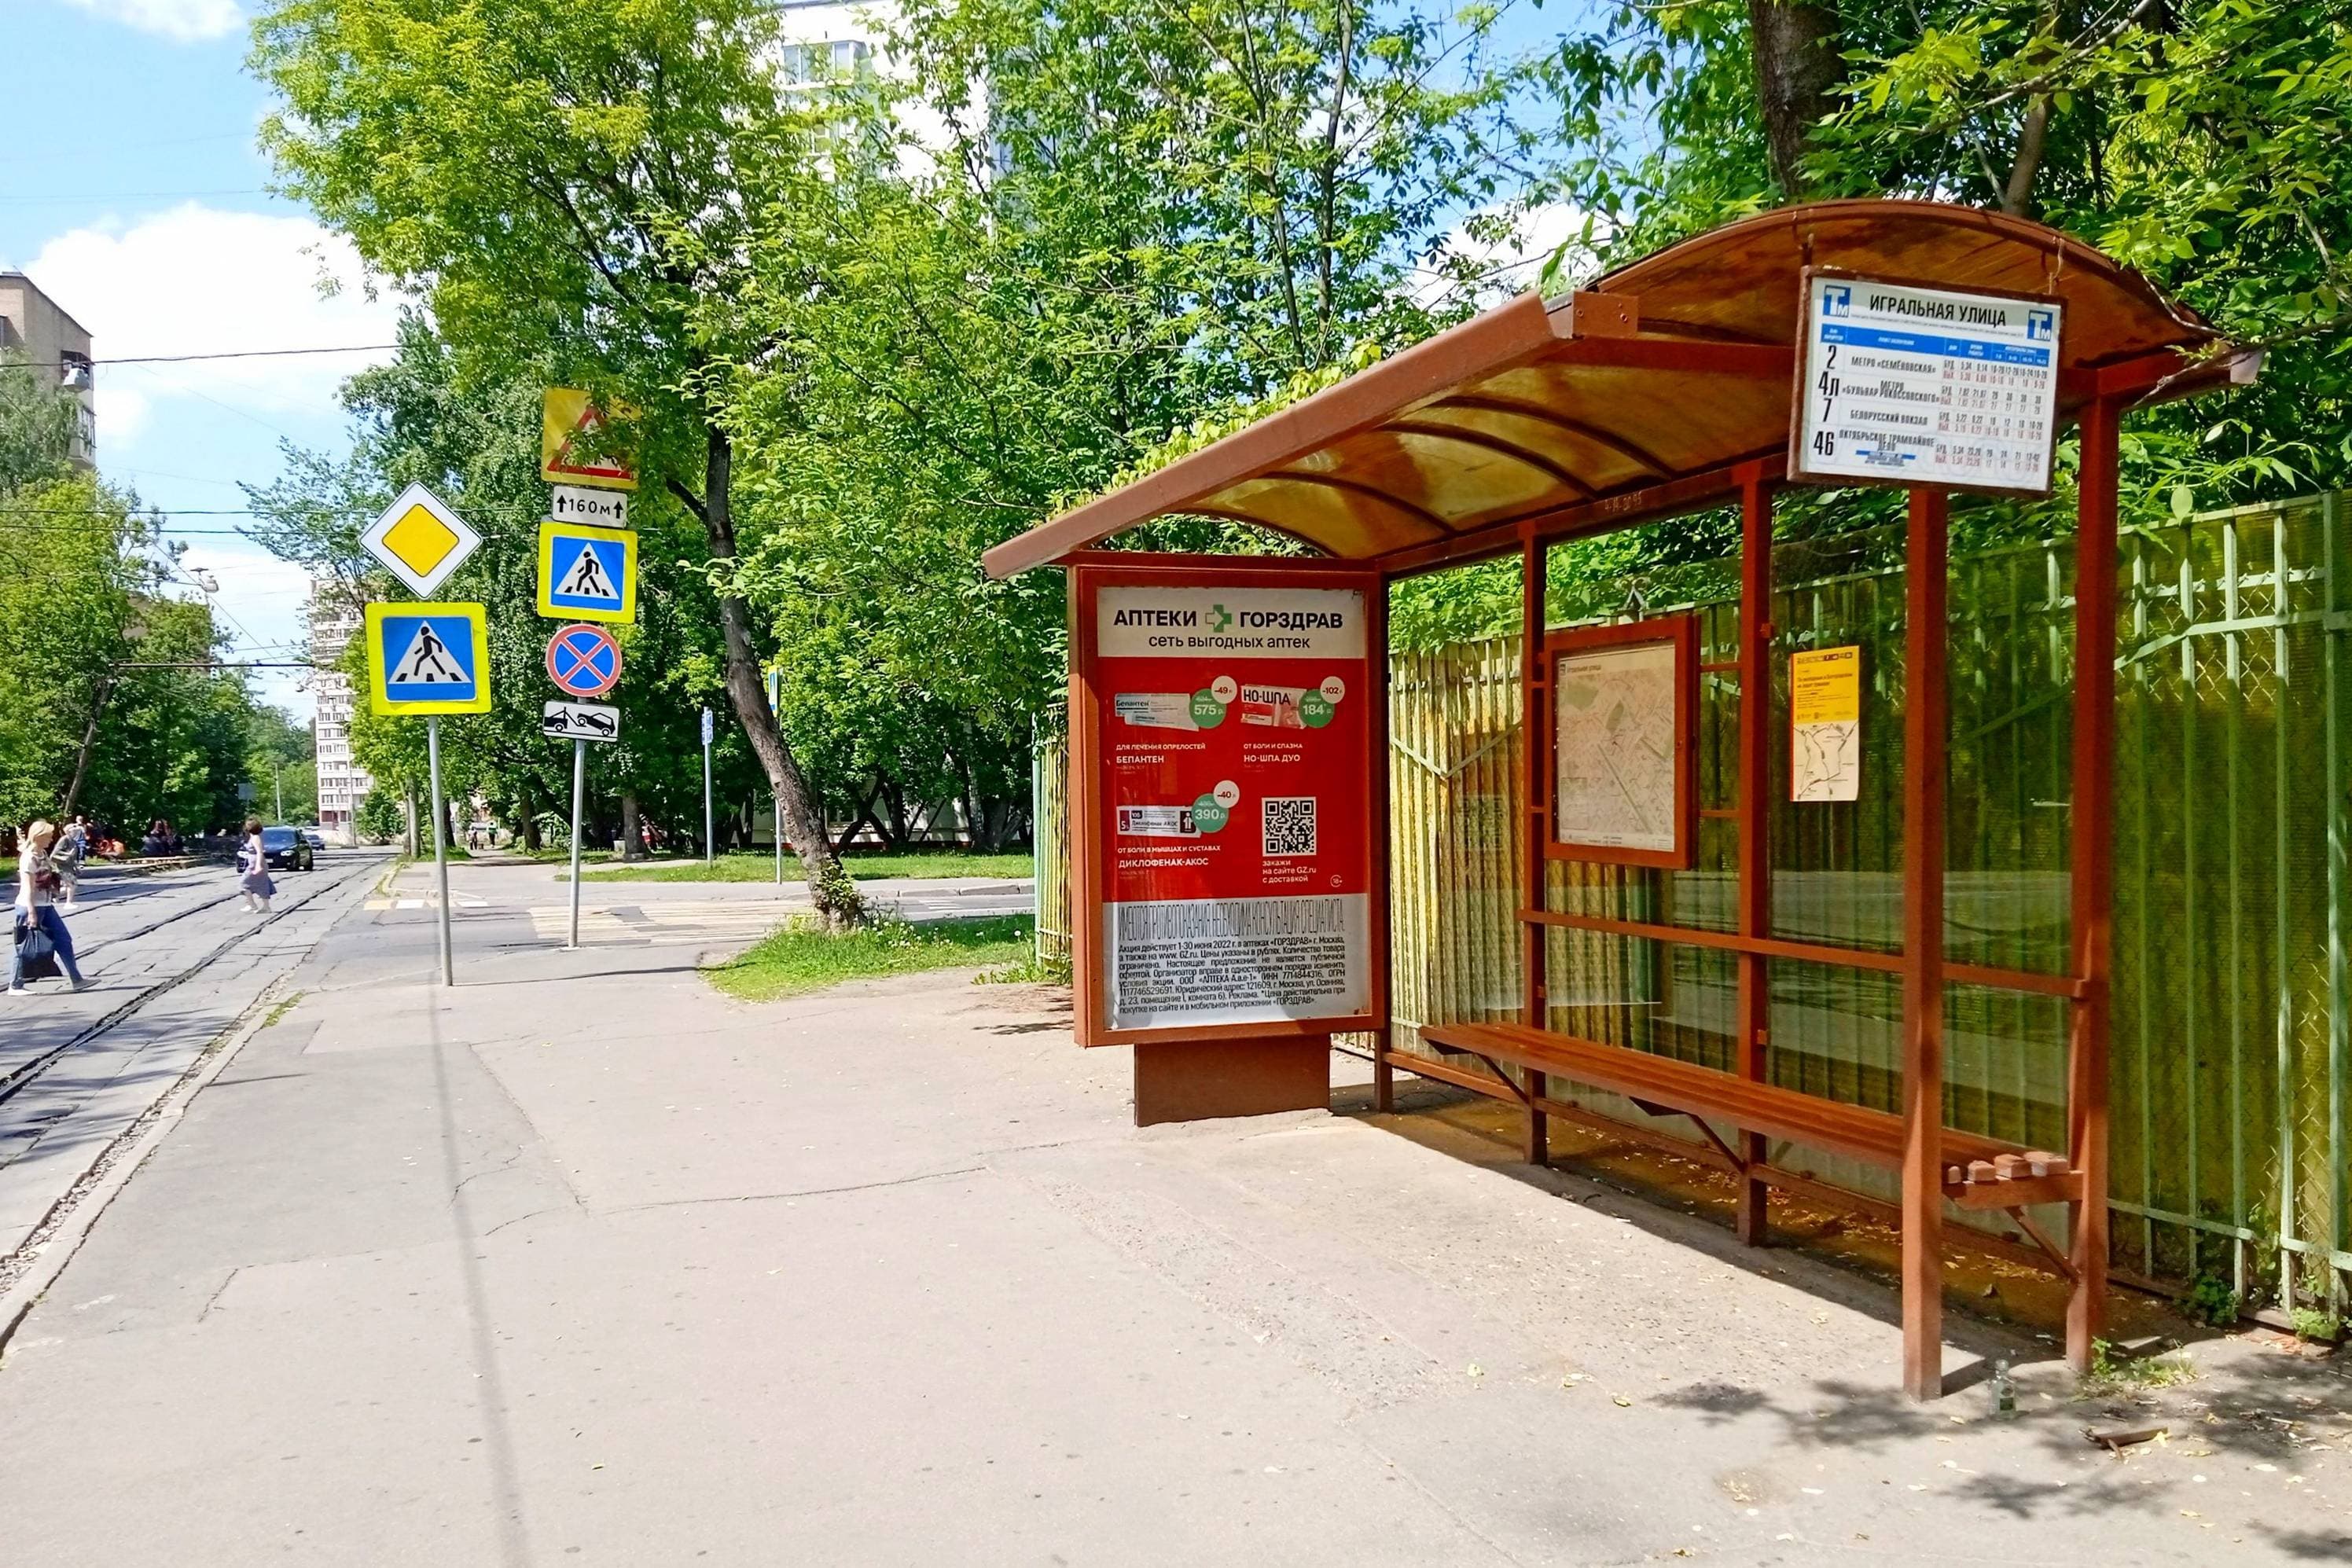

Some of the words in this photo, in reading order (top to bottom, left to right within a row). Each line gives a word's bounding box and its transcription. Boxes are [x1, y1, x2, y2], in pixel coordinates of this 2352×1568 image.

[1869, 295, 1955, 321] ИГРАЛЬНАЯ
[1957, 305, 2006, 328] УЛИЦА
[1827, 345, 1837, 369] 2
[1850, 356, 1876, 368] МЕТРО
[1823, 398, 1832, 422] 7
[1850, 409, 1899, 423] БЕЛОРУССКИЙ
[1814, 431, 1834, 456] 46
[1113, 610, 1197, 626] АПТЕКИ
[1240, 611, 1343, 630] ГОРЗДРАВ
[1148, 636, 1184, 648] сеть
[1188, 637, 1264, 649] выгодных
[1267, 637, 1310, 649] аптек
[1193, 704, 1217, 715] 575
[1116, 755, 1164, 764] БЕПАНТЕН
[1195, 809, 1219, 820] 390
[1119, 858, 1209, 868] ДИКЛОФЕНАК-АКОС
[1269, 875, 1308, 883] доставкой
[1141, 943, 1177, 953] действует
[1214, 940, 1231, 949] 2022
[1270, 937, 1312, 946] «ГОРЗДРАВ»
[1200, 949, 1219, 958] Цены
[1282, 945, 1321, 954] Количество
[1323, 945, 1345, 954] товара
[1167, 959, 1206, 968] Настоящее
[1310, 953, 1345, 962] публичной
[1119, 979, 1148, 989] условия
[1179, 976, 1194, 985] ООО
[1329, 969, 1346, 978] ОГРН
[1154, 968, 1196, 979] Организатор
[1199, 967, 1223, 976] вправе
[1231, 965, 1283, 975] одностороннем
[1284, 964, 1313, 972] порядке
[1141, 995, 1181, 1004] помещение
[1283, 987, 1332, 997] действительна
[1175, 984, 1222, 993] Юридический
[1119, 1006, 1148, 1015] покупке
[1159, 1004, 1178, 1012] сайте
[1190, 1001, 1229, 1011] мобильном
[1230, 1000, 1272, 1009] приложении
